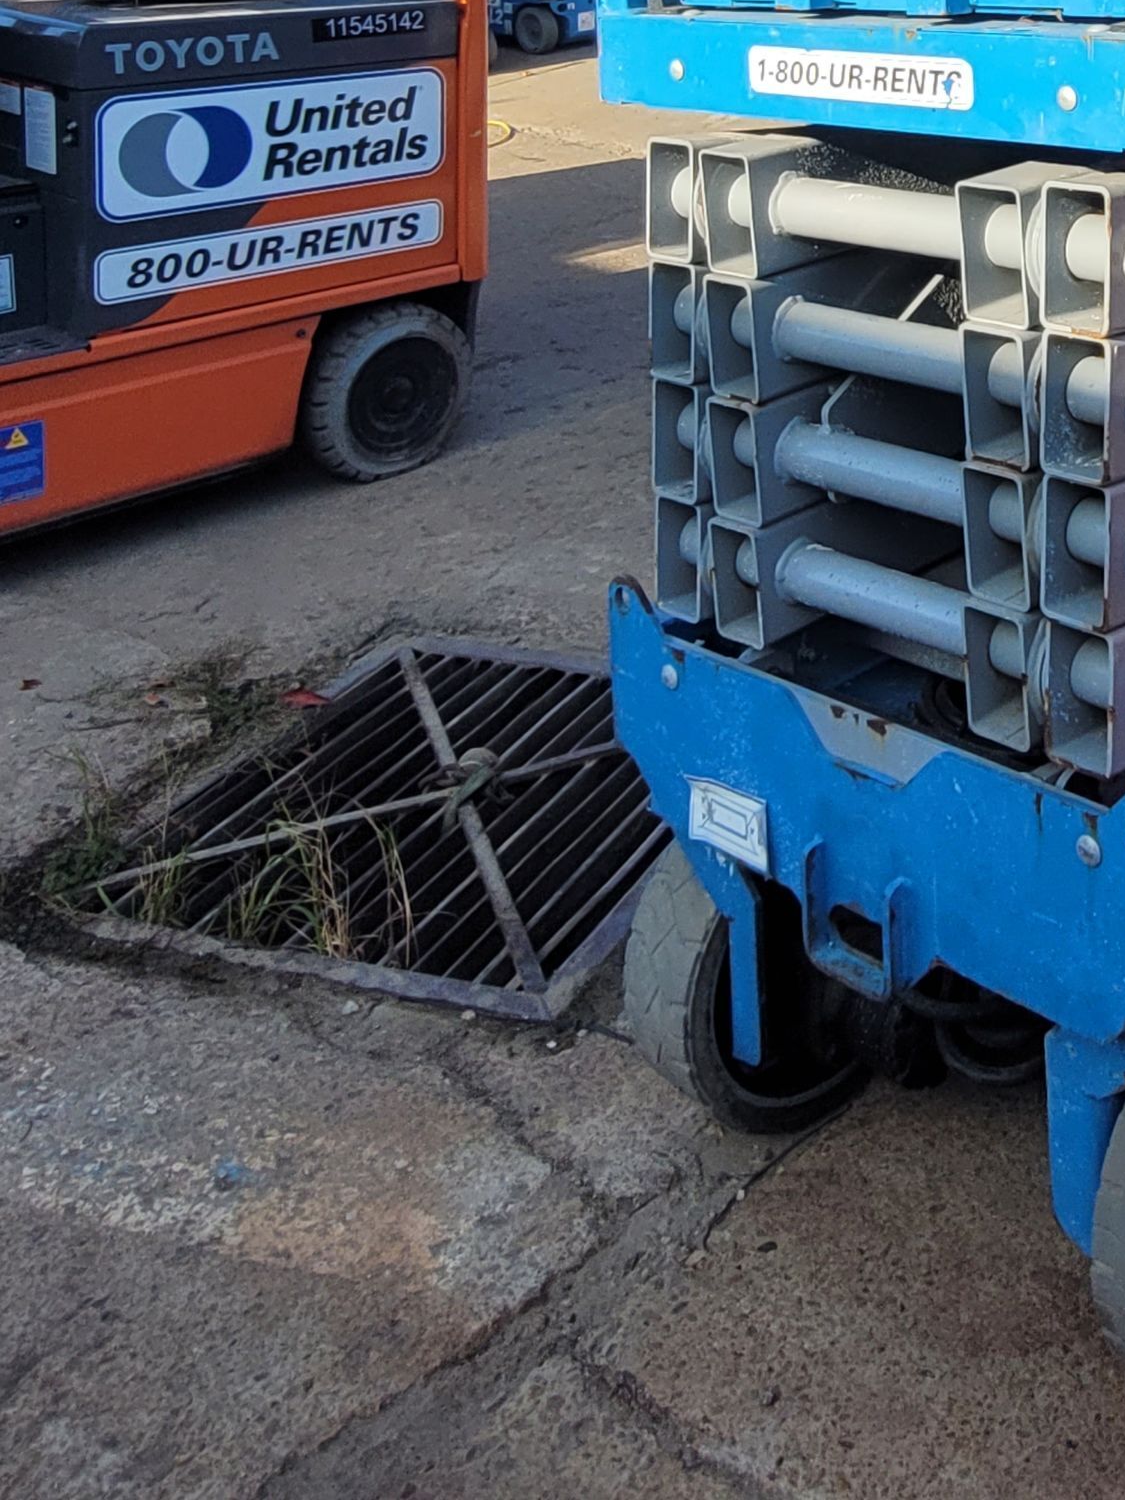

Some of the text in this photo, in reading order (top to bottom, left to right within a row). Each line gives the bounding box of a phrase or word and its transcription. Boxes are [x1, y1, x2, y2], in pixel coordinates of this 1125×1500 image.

[325, 10, 425, 39] 11545142
[104, 32, 280, 75] TOYOTA
[264, 84, 418, 138] United
[262, 126, 429, 182] Rentals
[126, 211, 421, 289] 800-UR-RENTS
